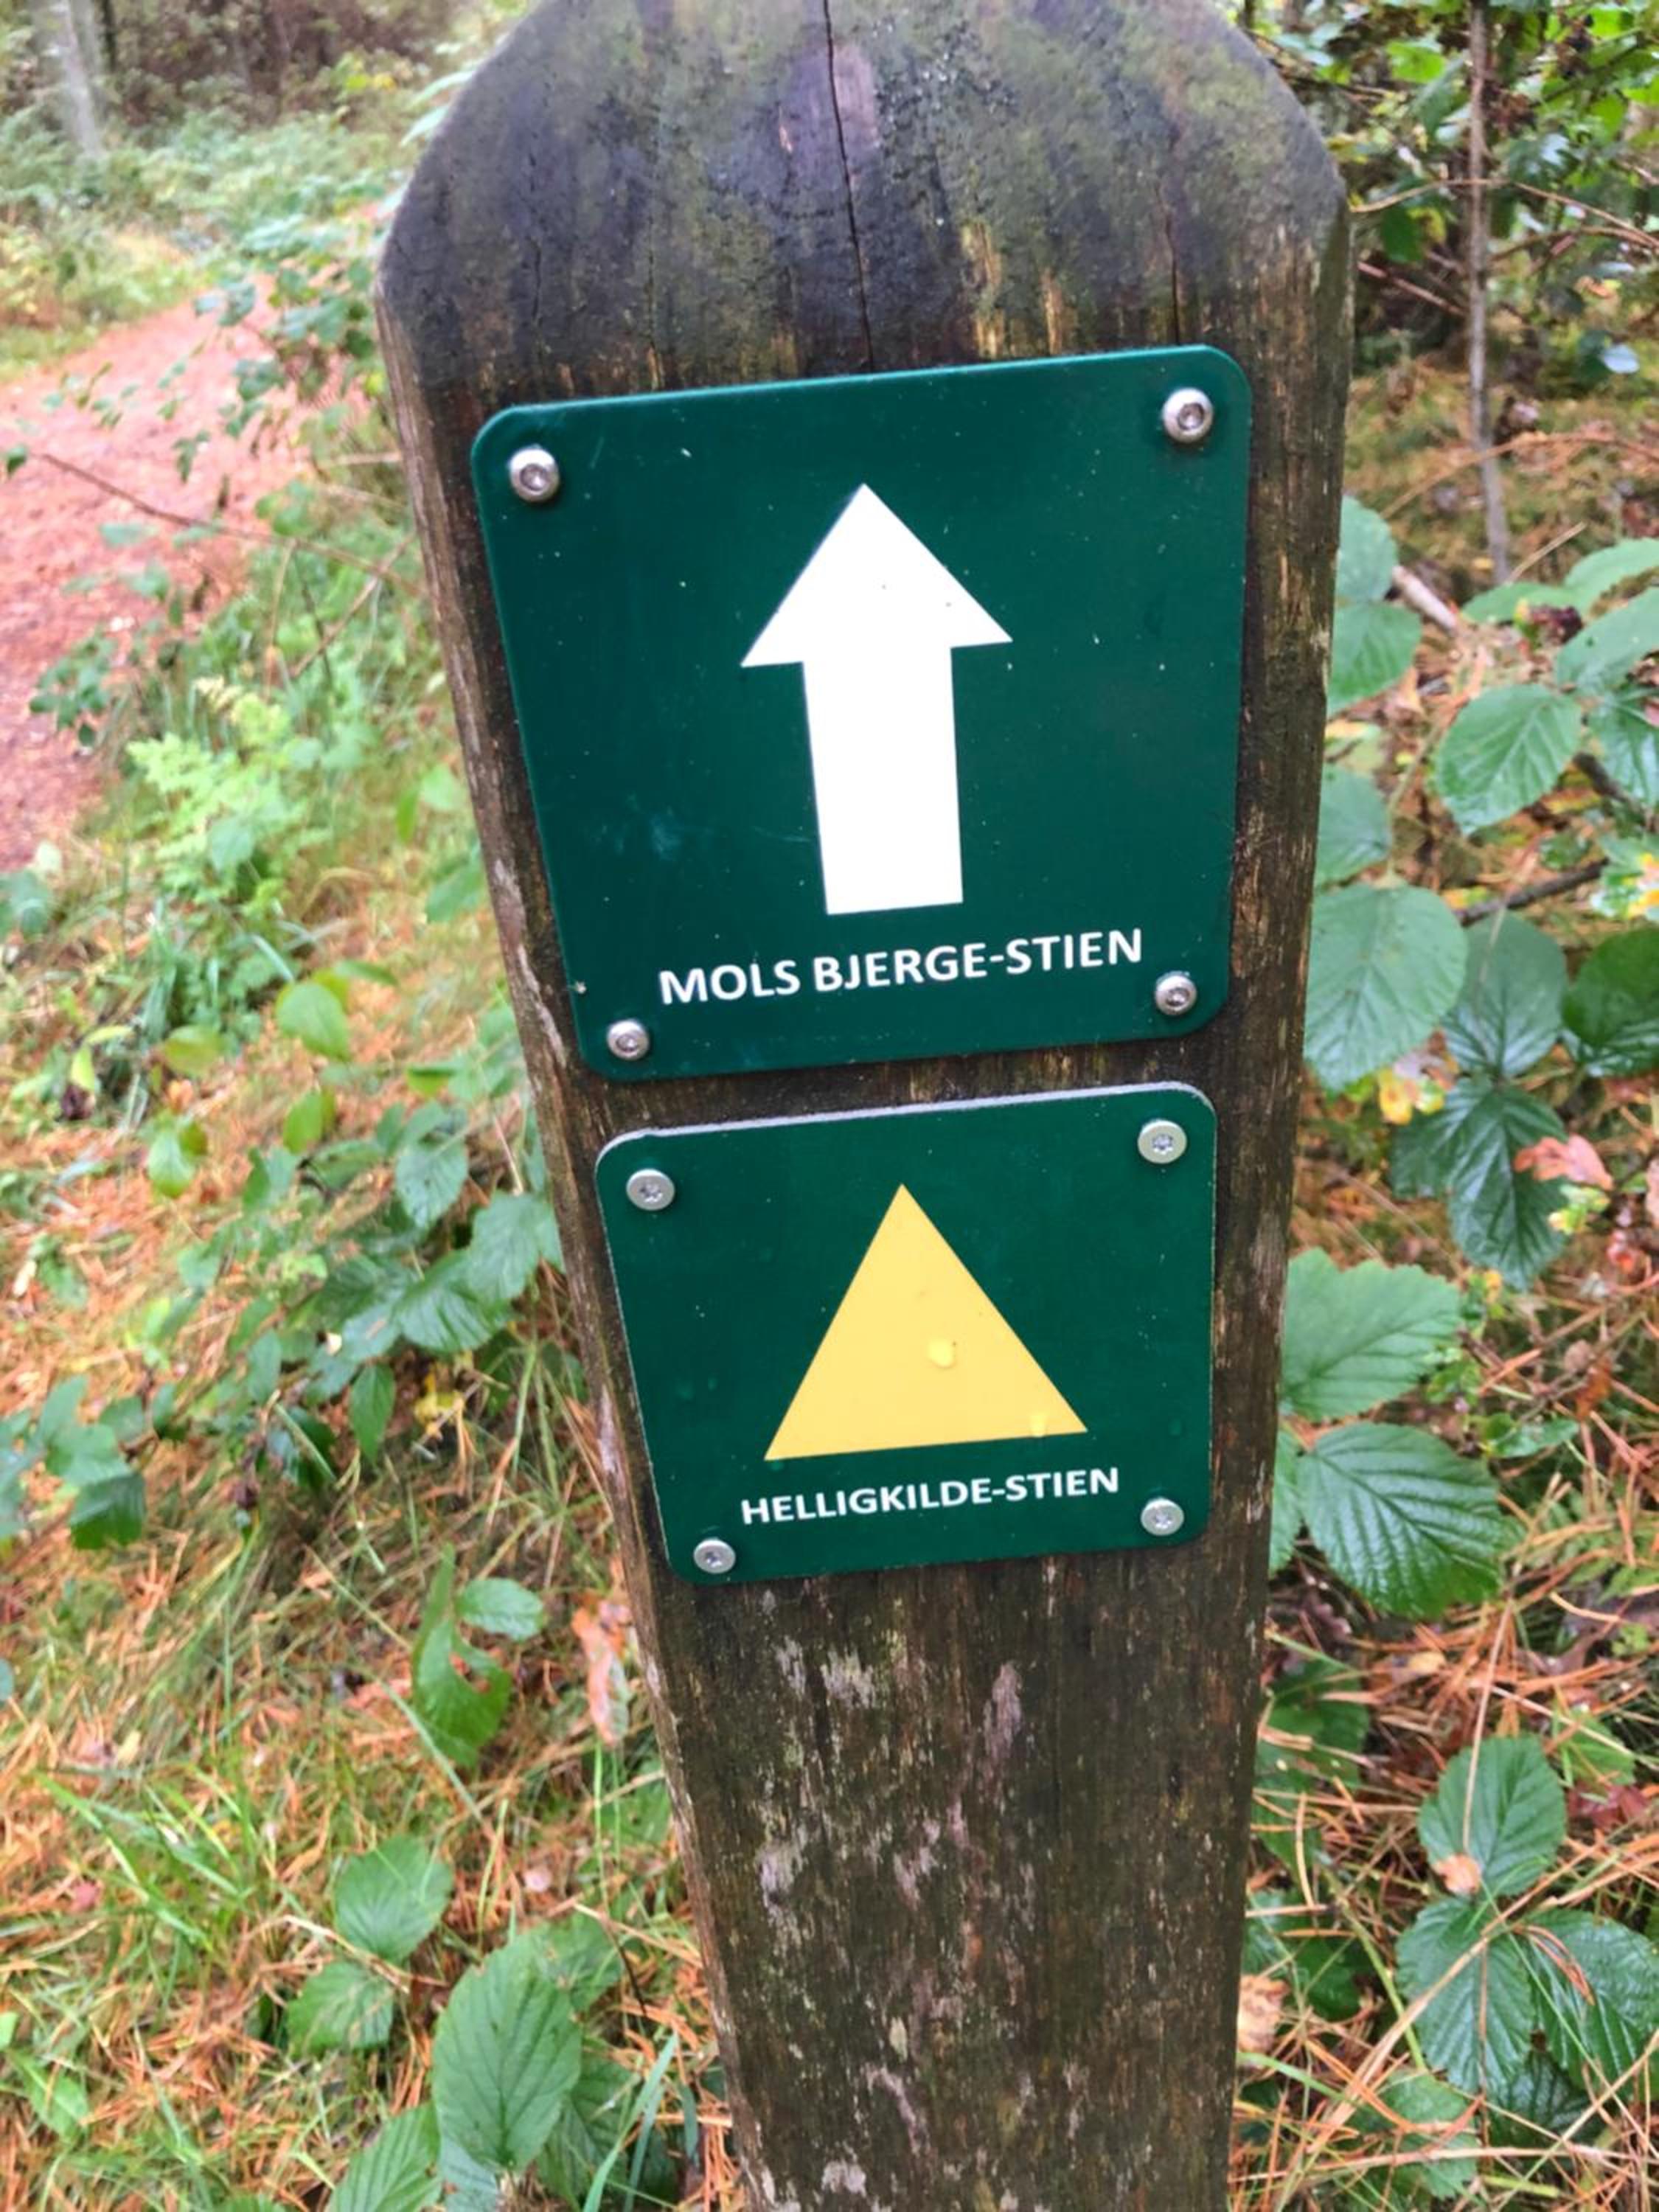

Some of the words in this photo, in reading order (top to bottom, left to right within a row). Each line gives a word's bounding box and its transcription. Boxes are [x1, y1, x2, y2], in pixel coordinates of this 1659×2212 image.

[658, 960, 801, 1005] MOLS
[813, 928, 1143, 992] BJERGE-STIEN
[740, 1467, 1119, 1525] HELLIGKILDE-STIEN
